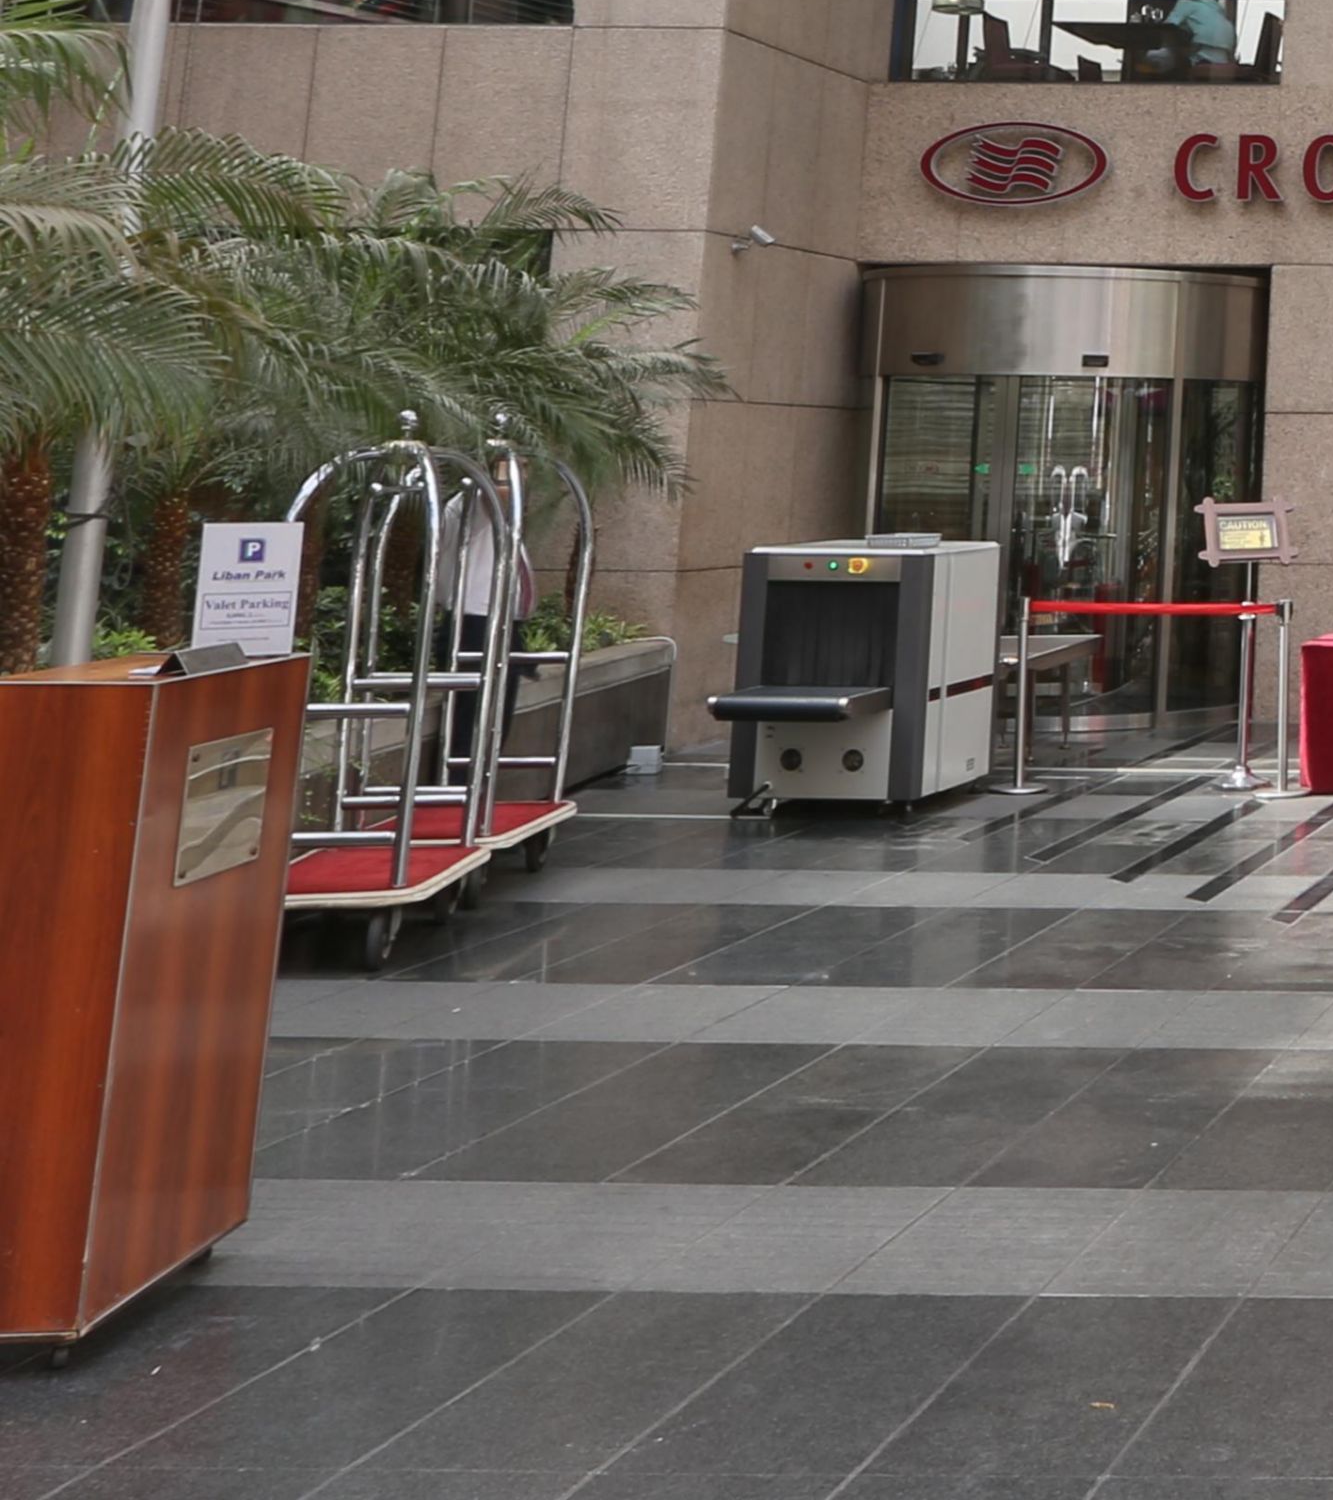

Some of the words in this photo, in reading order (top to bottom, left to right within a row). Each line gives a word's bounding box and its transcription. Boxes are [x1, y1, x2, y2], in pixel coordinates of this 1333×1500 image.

[212, 570, 250, 582] Liban
[253, 569, 286, 581] Park
[205, 599, 237, 611] Valet
[240, 597, 290, 611] Parking
